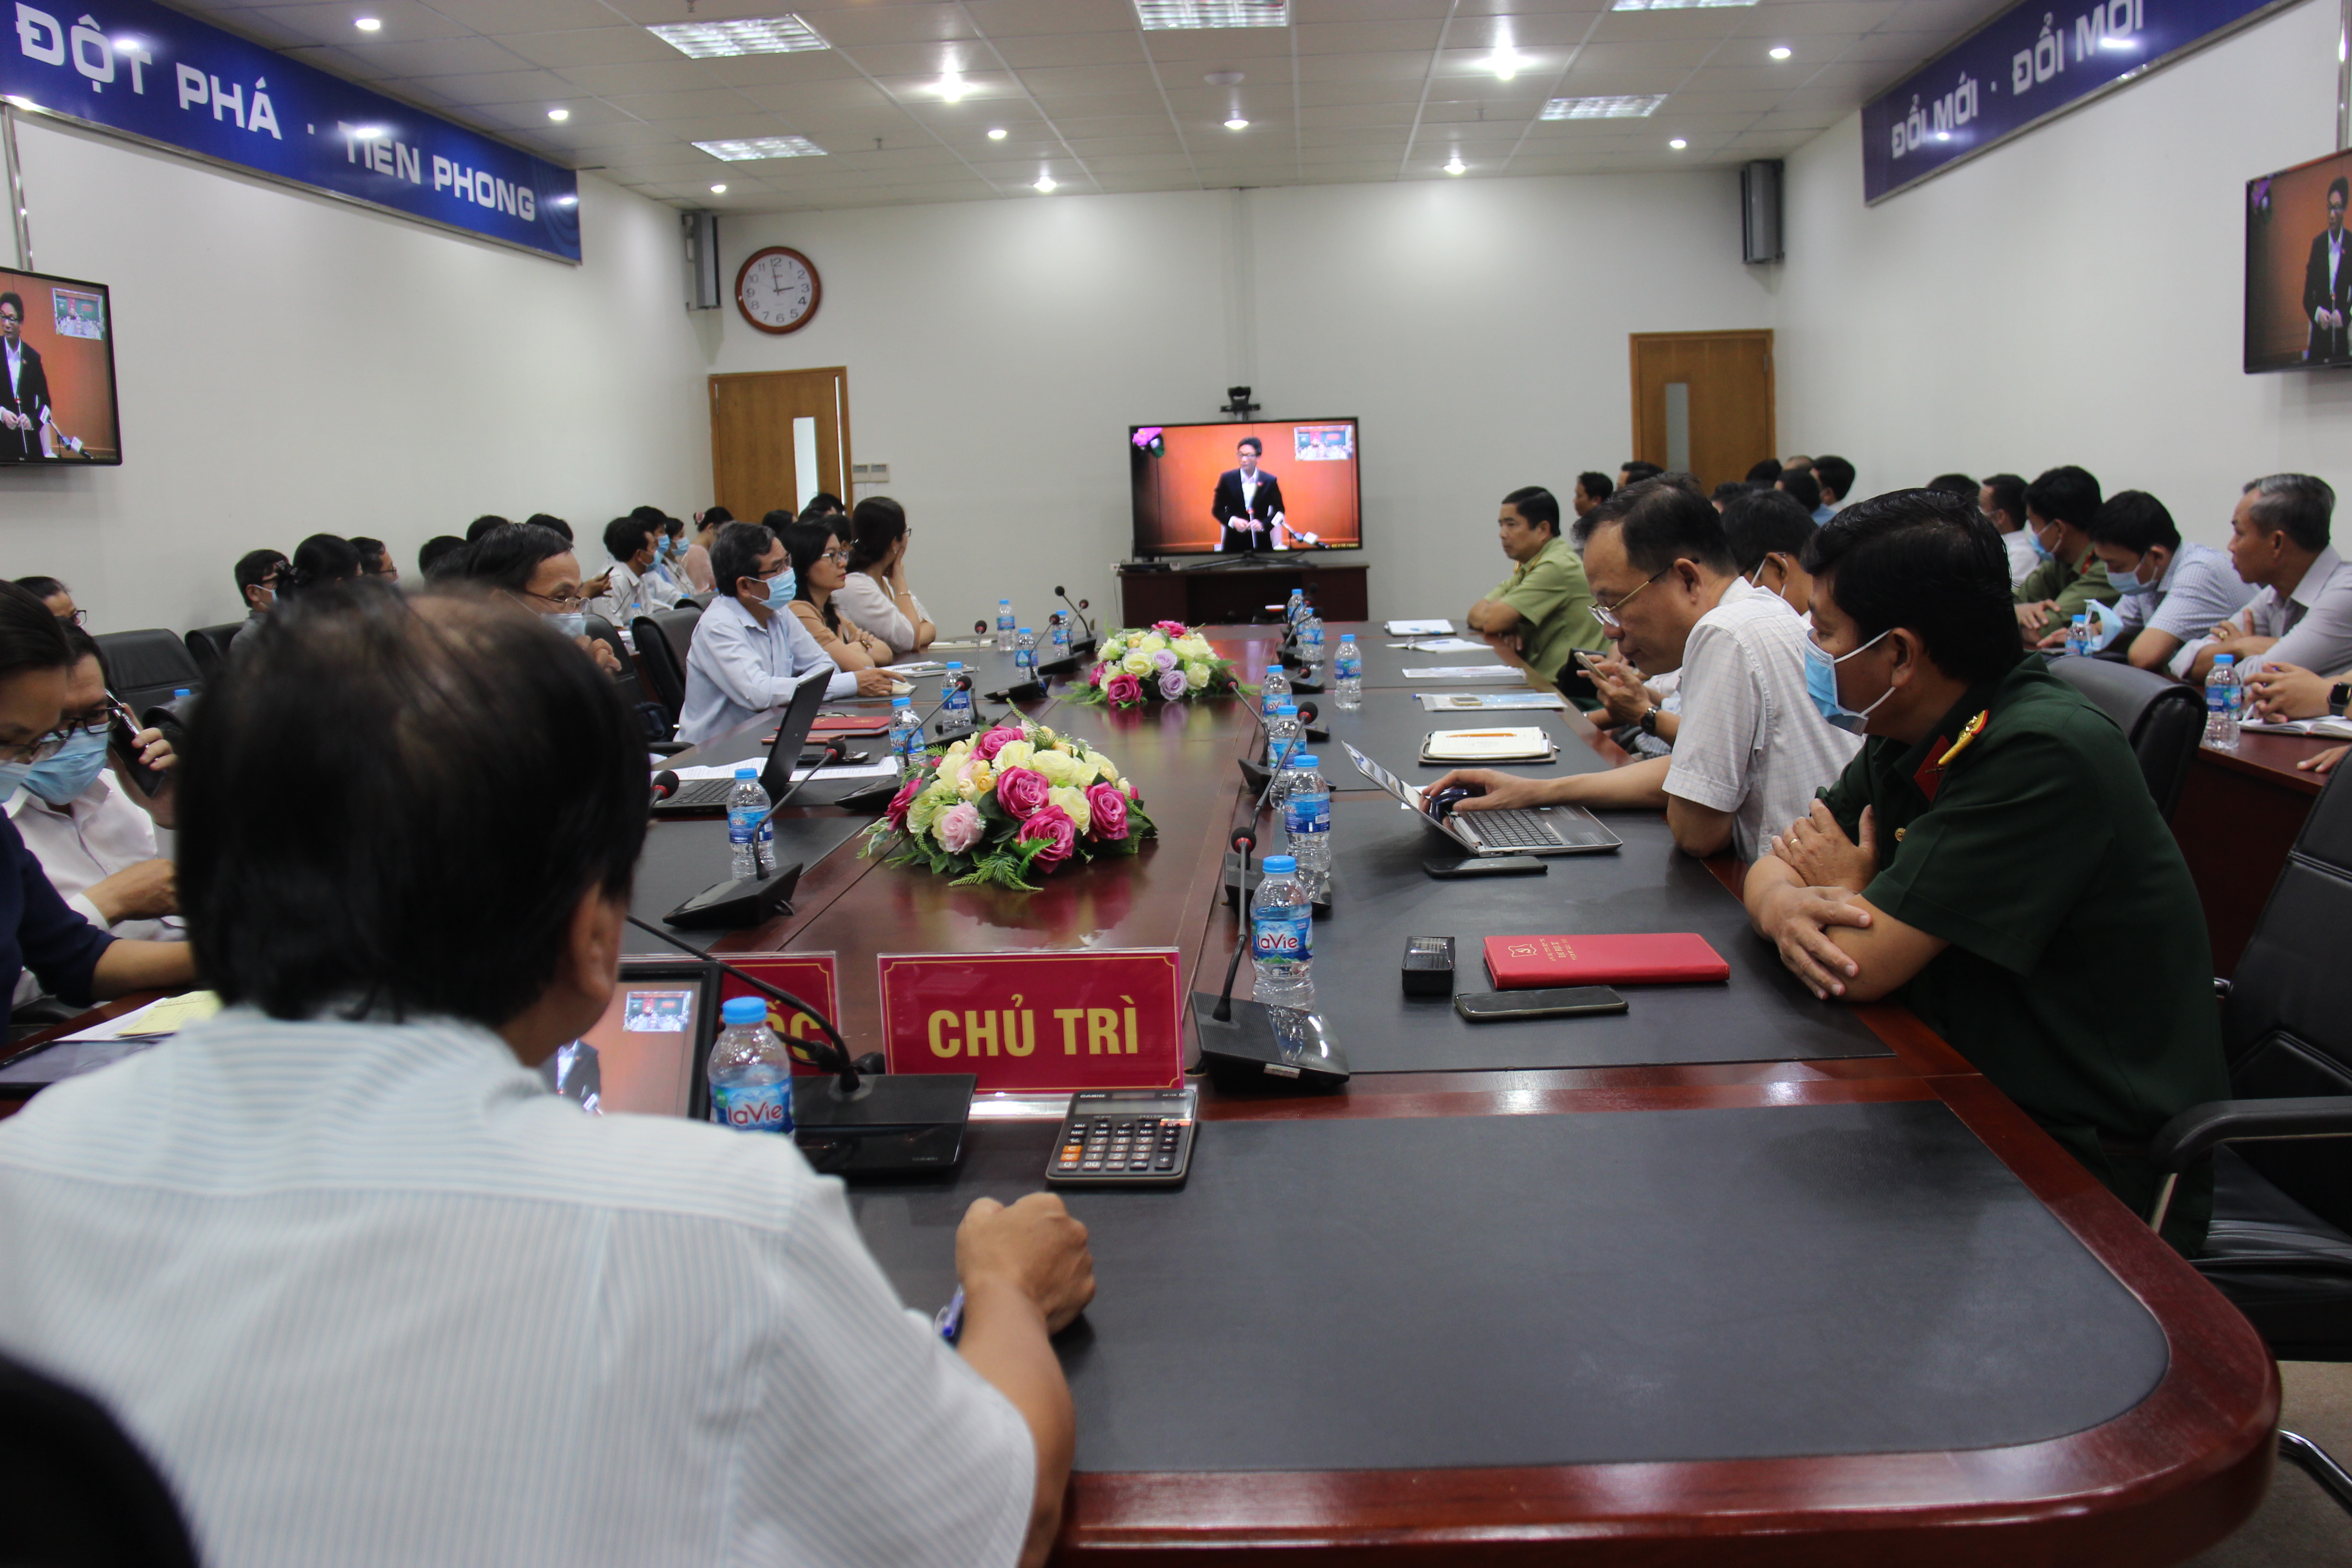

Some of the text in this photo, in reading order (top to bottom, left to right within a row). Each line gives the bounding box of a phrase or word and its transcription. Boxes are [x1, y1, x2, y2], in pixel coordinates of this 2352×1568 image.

[1891, 93, 1927, 159] ĐỔI
[1933, 70, 1979, 135] MỚI
[2012, 11, 2064, 96] ĐỔI
[15, 1, 152, 95] ĐỘT
[176, 62, 282, 140] PHÁ
[433, 155, 535, 222] PHONG
[798, 270, 805, 279] 2
[746, 288, 755, 297] 9
[801, 284, 809, 293] 3
[751, 300, 760, 309] 8
[798, 296, 806, 305] 4
[762, 311, 769, 320] 7
[790, 309, 798, 318] 5
[776, 314, 784, 323] 6
[1257, 933, 1298, 949] laVie
[927, 993, 1138, 1058] CHỦ TRÌ
[727, 1101, 783, 1124] laVie
